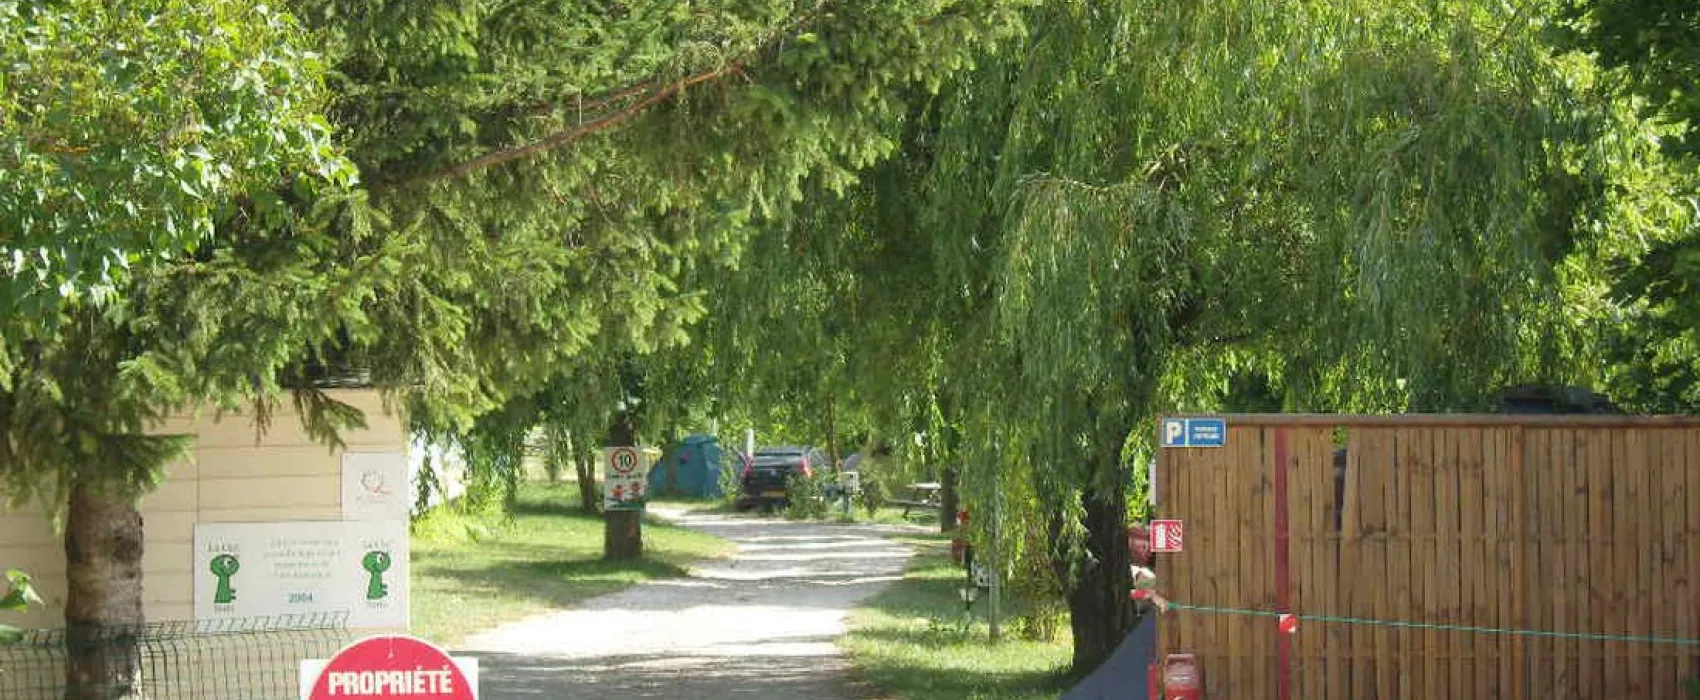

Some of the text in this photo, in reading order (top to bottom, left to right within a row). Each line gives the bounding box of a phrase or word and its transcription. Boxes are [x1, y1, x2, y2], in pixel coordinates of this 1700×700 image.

[1167, 422, 1181, 444] P
[620, 454, 631, 467] 10
[328, 666, 453, 696] PROPRIÉTÉ
